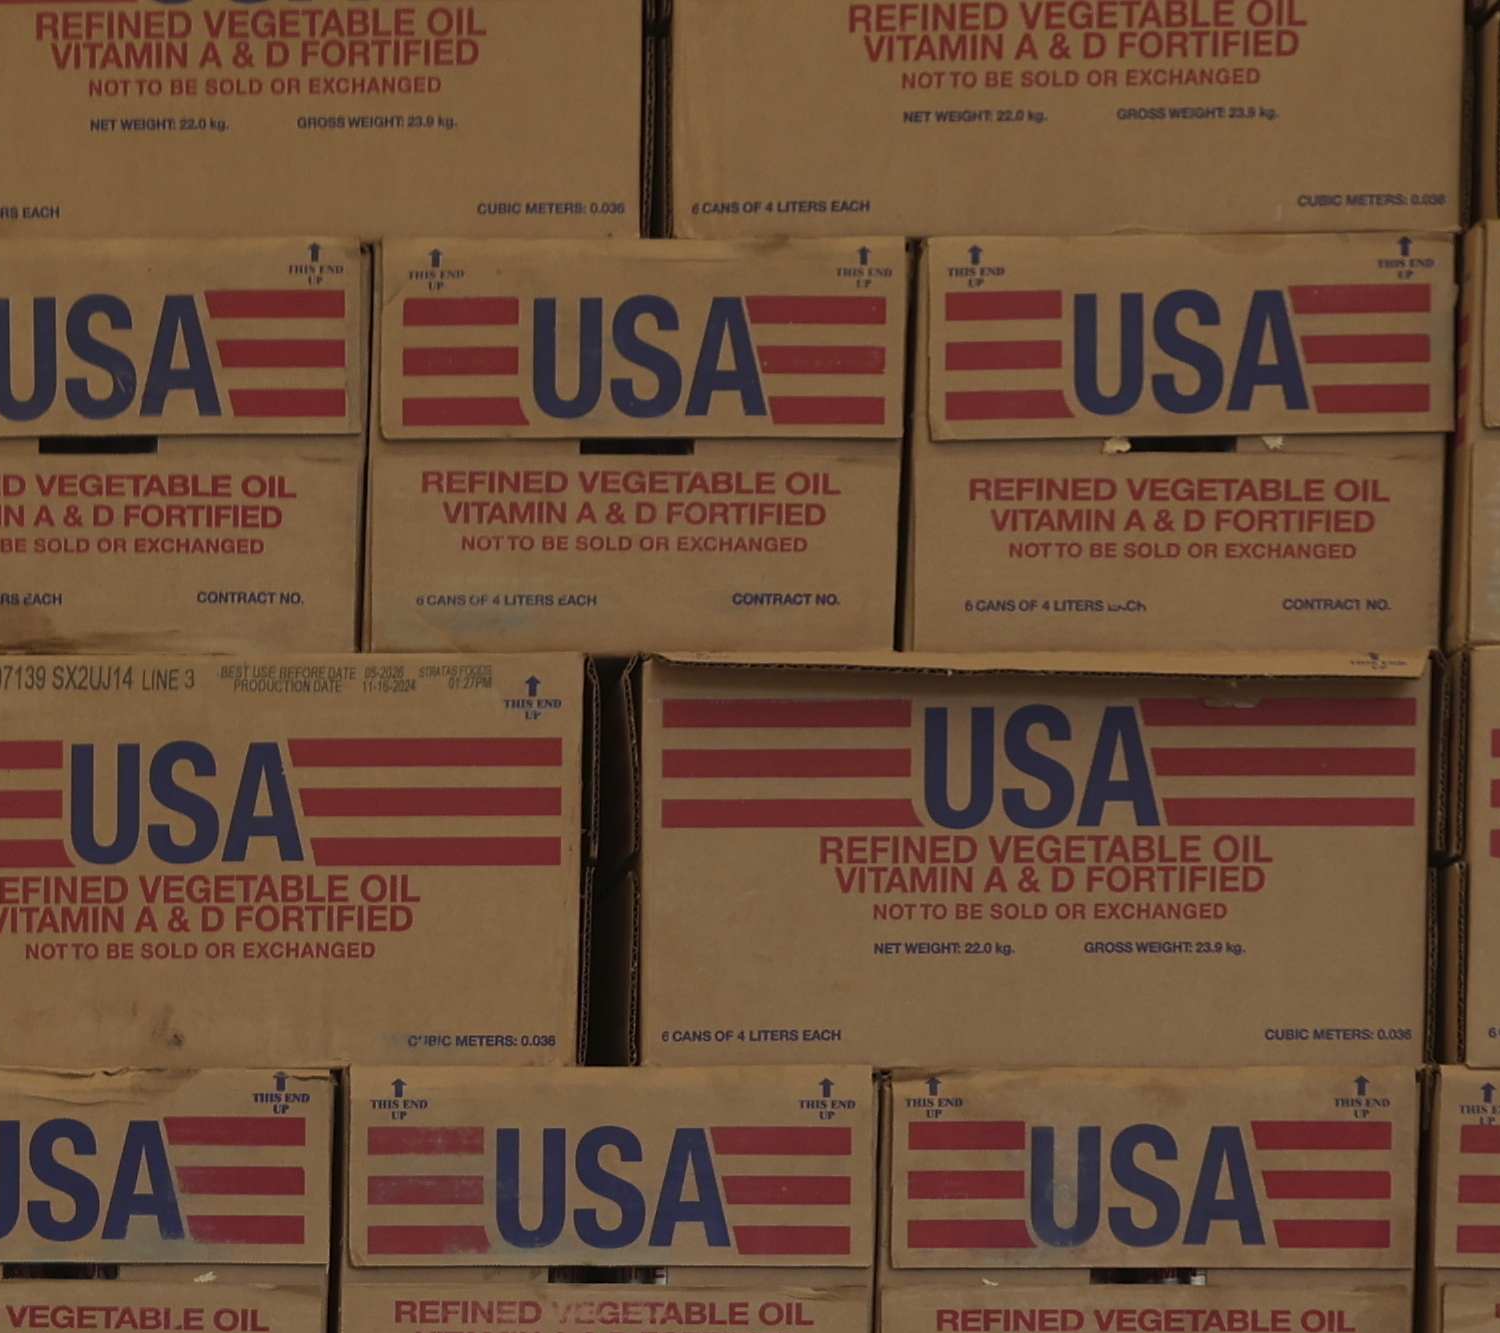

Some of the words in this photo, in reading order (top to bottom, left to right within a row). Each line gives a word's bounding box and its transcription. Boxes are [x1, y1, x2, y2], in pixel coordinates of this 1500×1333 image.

[534, 295, 766, 418] USA
[36, 474, 232, 498] VEGETABLE
[241, 475, 297, 498] OIL
[34, 504, 55, 528] A
[63, 505, 84, 528] &
[93, 505, 115, 528] D
[124, 504, 284, 529] FORTIFIED
[221, 666, 247, 679] BEST
[253, 666, 276, 679] USE
[279, 666, 325, 680] BEFORE
[328, 667, 356, 680] DATE
[234, 679, 310, 692] PRODUCTION
[314, 679, 342, 692] DATE
[72, 741, 303, 864] USA
